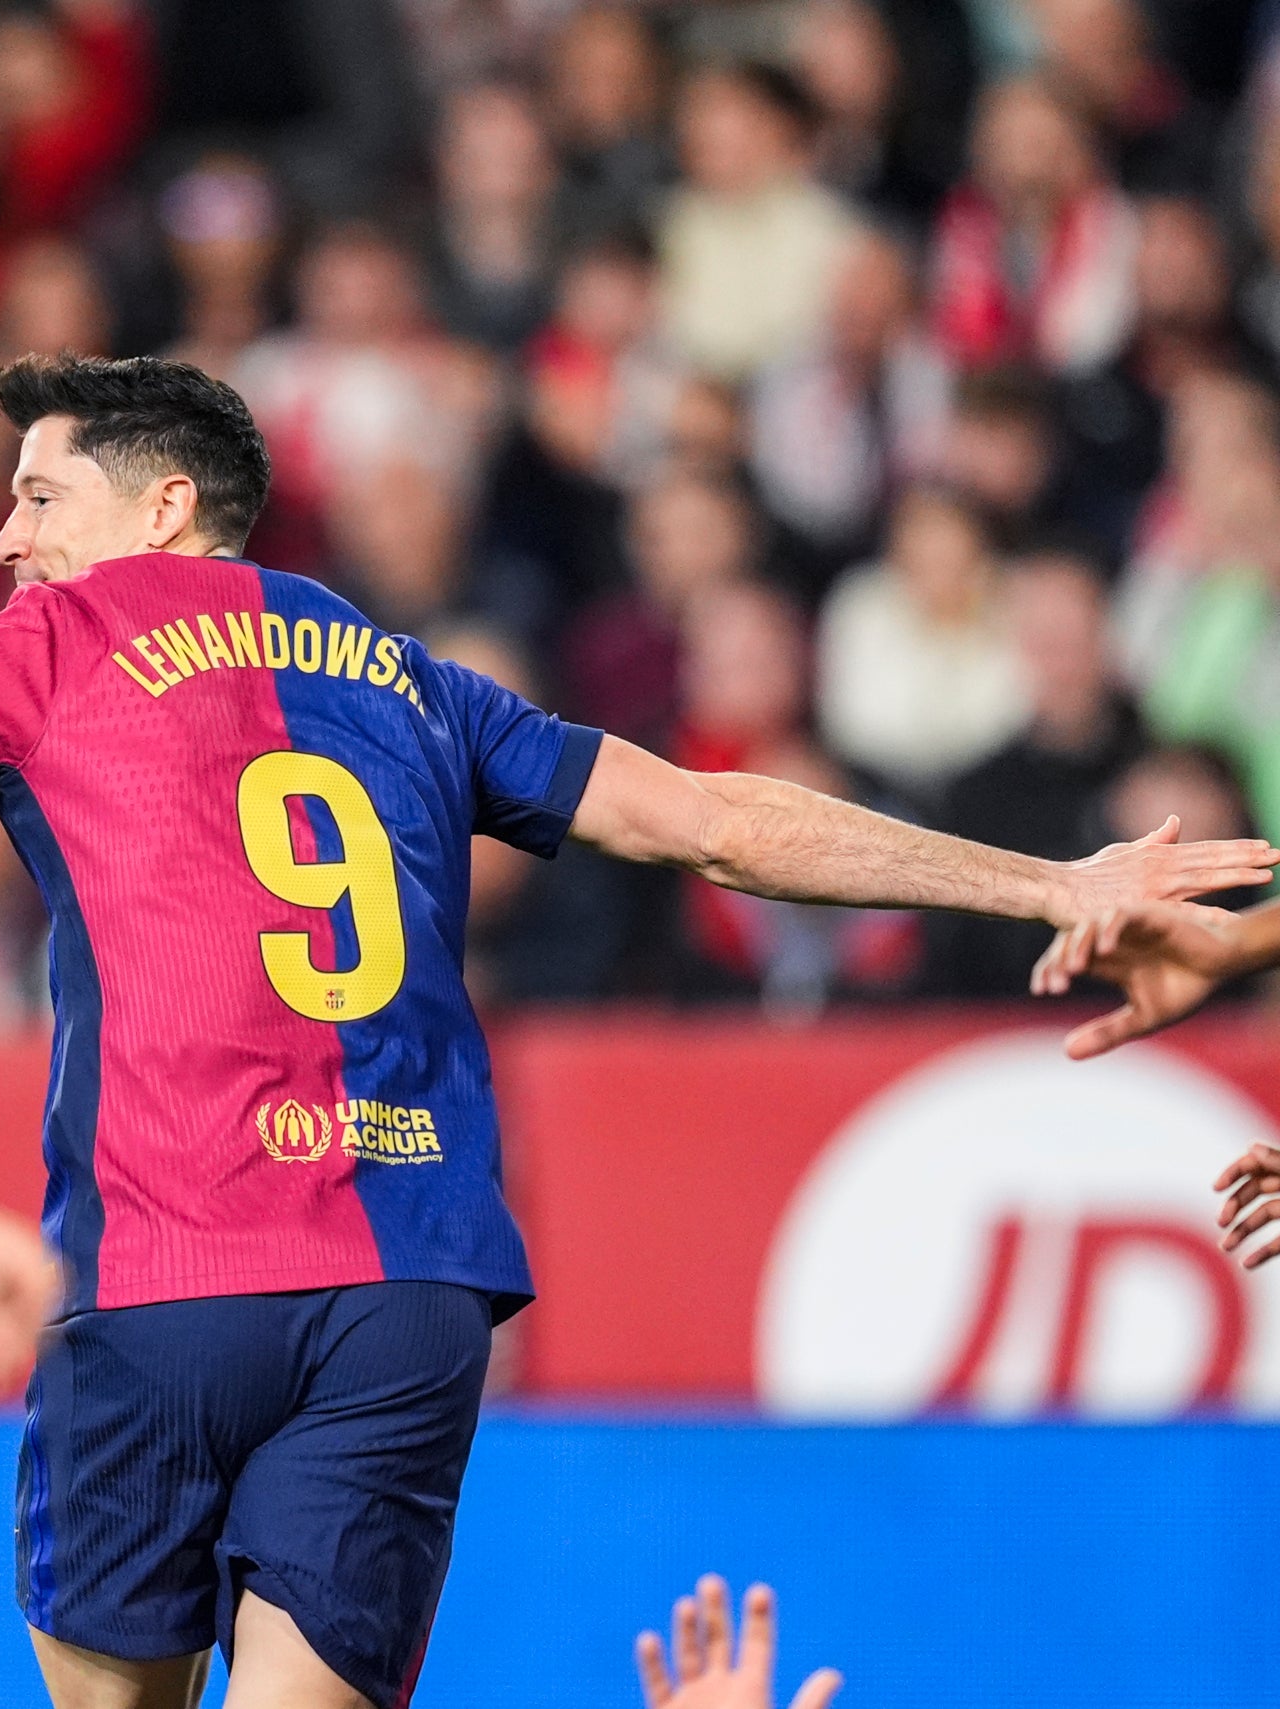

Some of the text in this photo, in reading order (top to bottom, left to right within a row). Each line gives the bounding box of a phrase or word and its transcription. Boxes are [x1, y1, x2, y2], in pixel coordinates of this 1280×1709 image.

[111, 611, 426, 717] LEWANDOWS
[236, 750, 407, 1023] 9
[335, 1098, 435, 1131] UNHCR
[340, 1123, 442, 1155] ACNUR
[341, 1147, 443, 1165] The UN Refugee Agency
